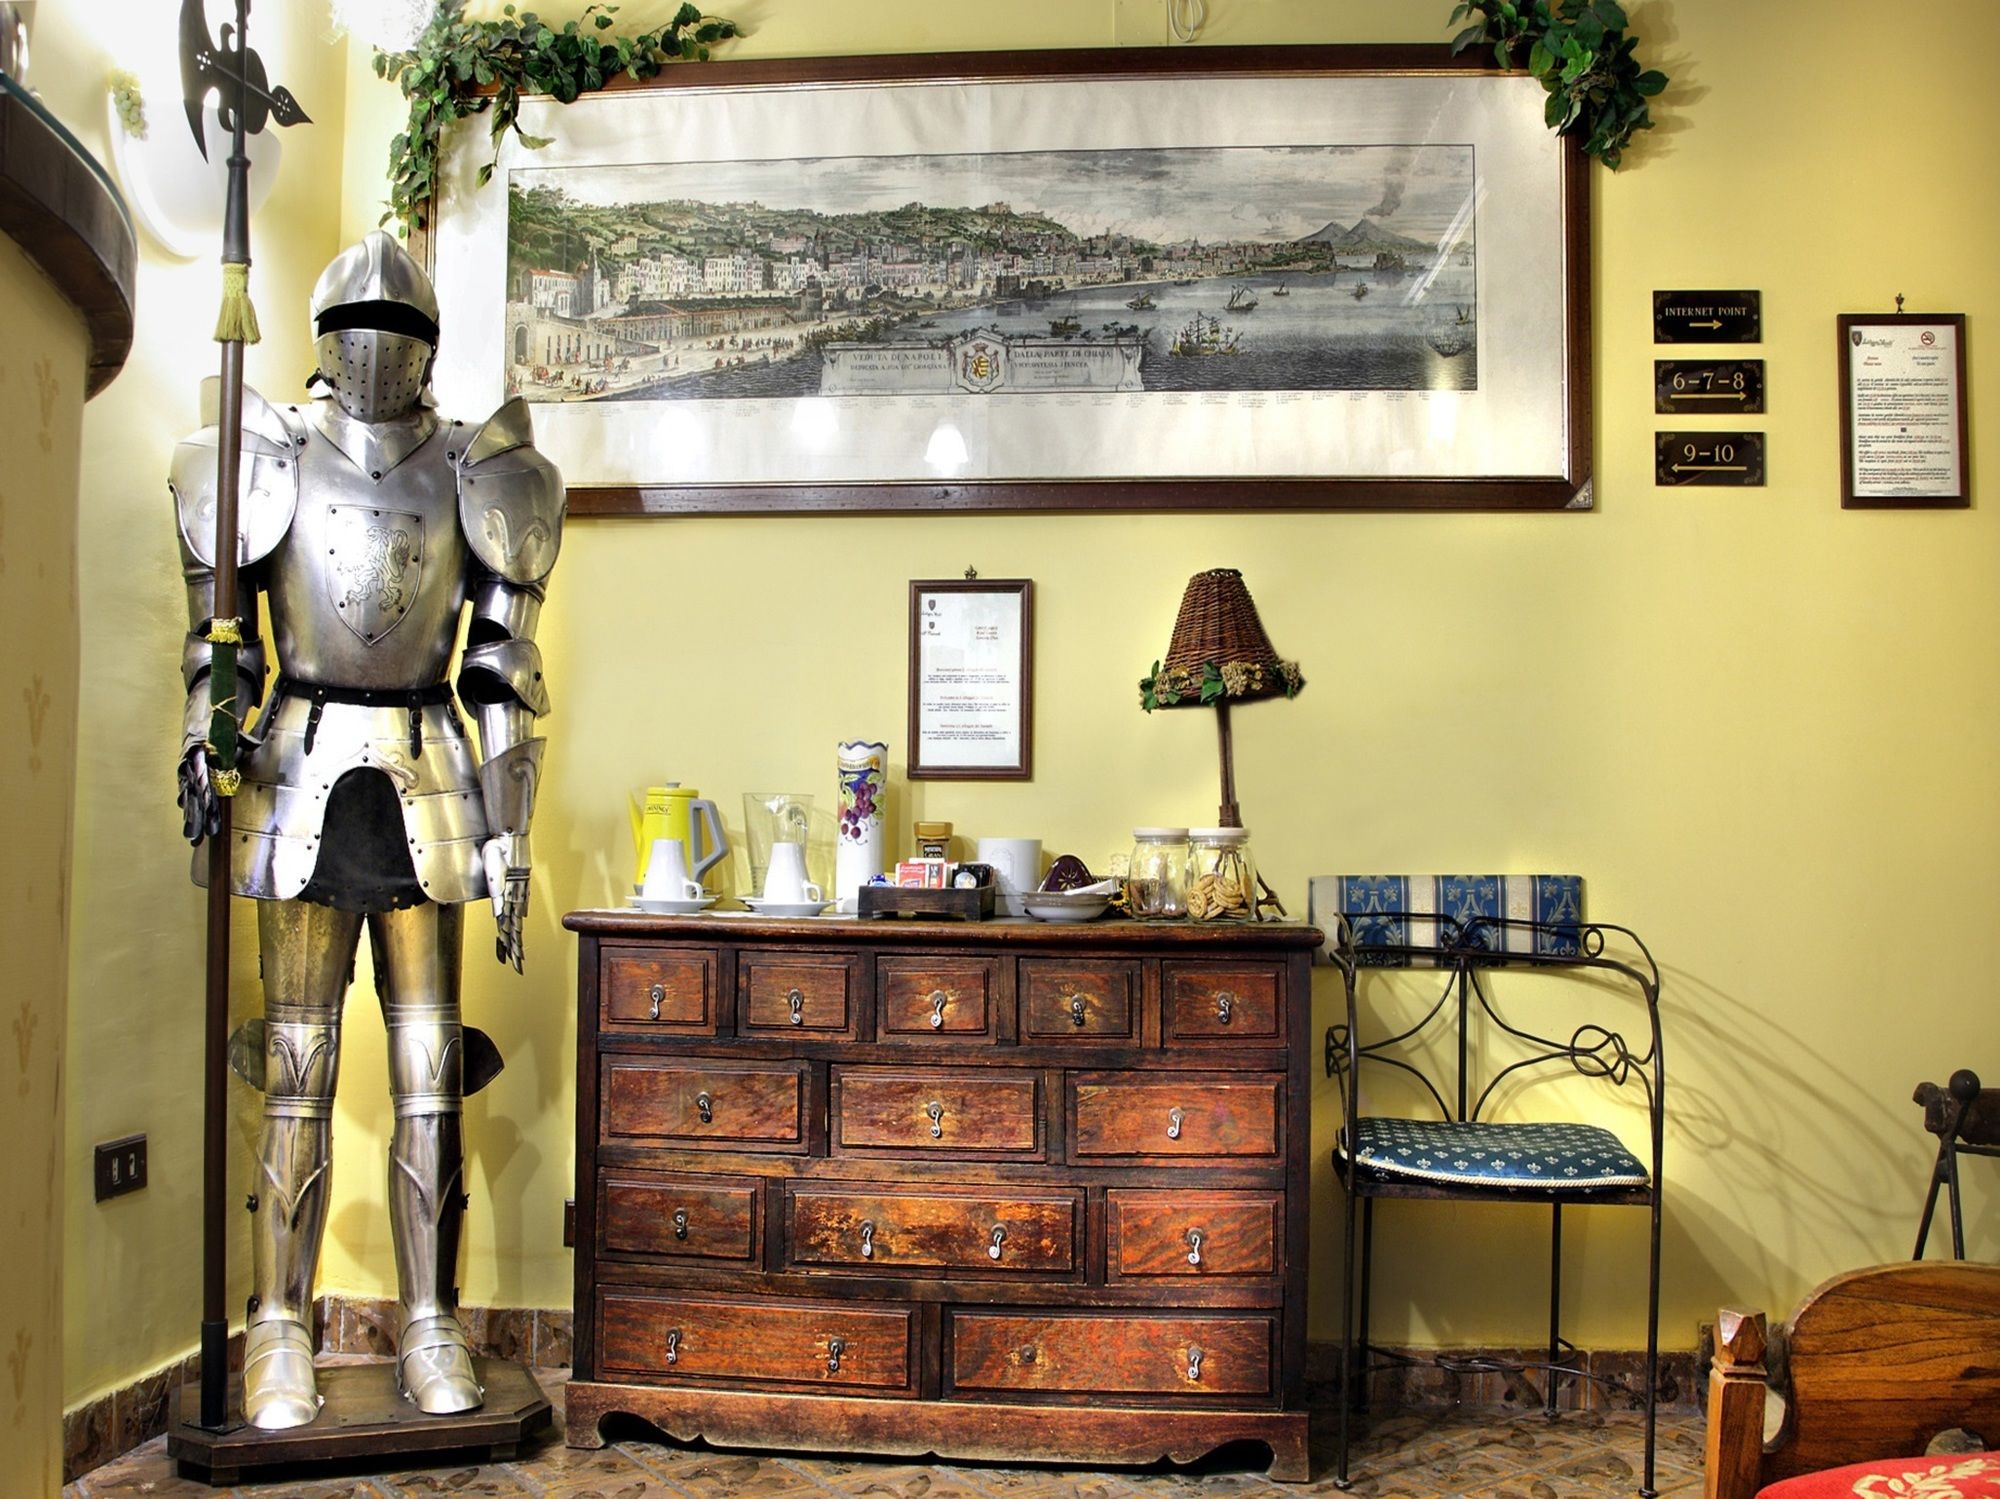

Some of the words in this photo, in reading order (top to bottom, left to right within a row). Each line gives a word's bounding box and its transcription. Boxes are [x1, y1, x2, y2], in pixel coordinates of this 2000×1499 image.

[1665, 307, 1714, 317] INTERNET
[1718, 306, 1747, 316] POINT
[853, 353, 888, 361] VEDUTA
[904, 352, 943, 361] NAPOLI
[1673, 372, 1745, 390] 6-7-8
[1684, 444, 1735, 462] 9-10
